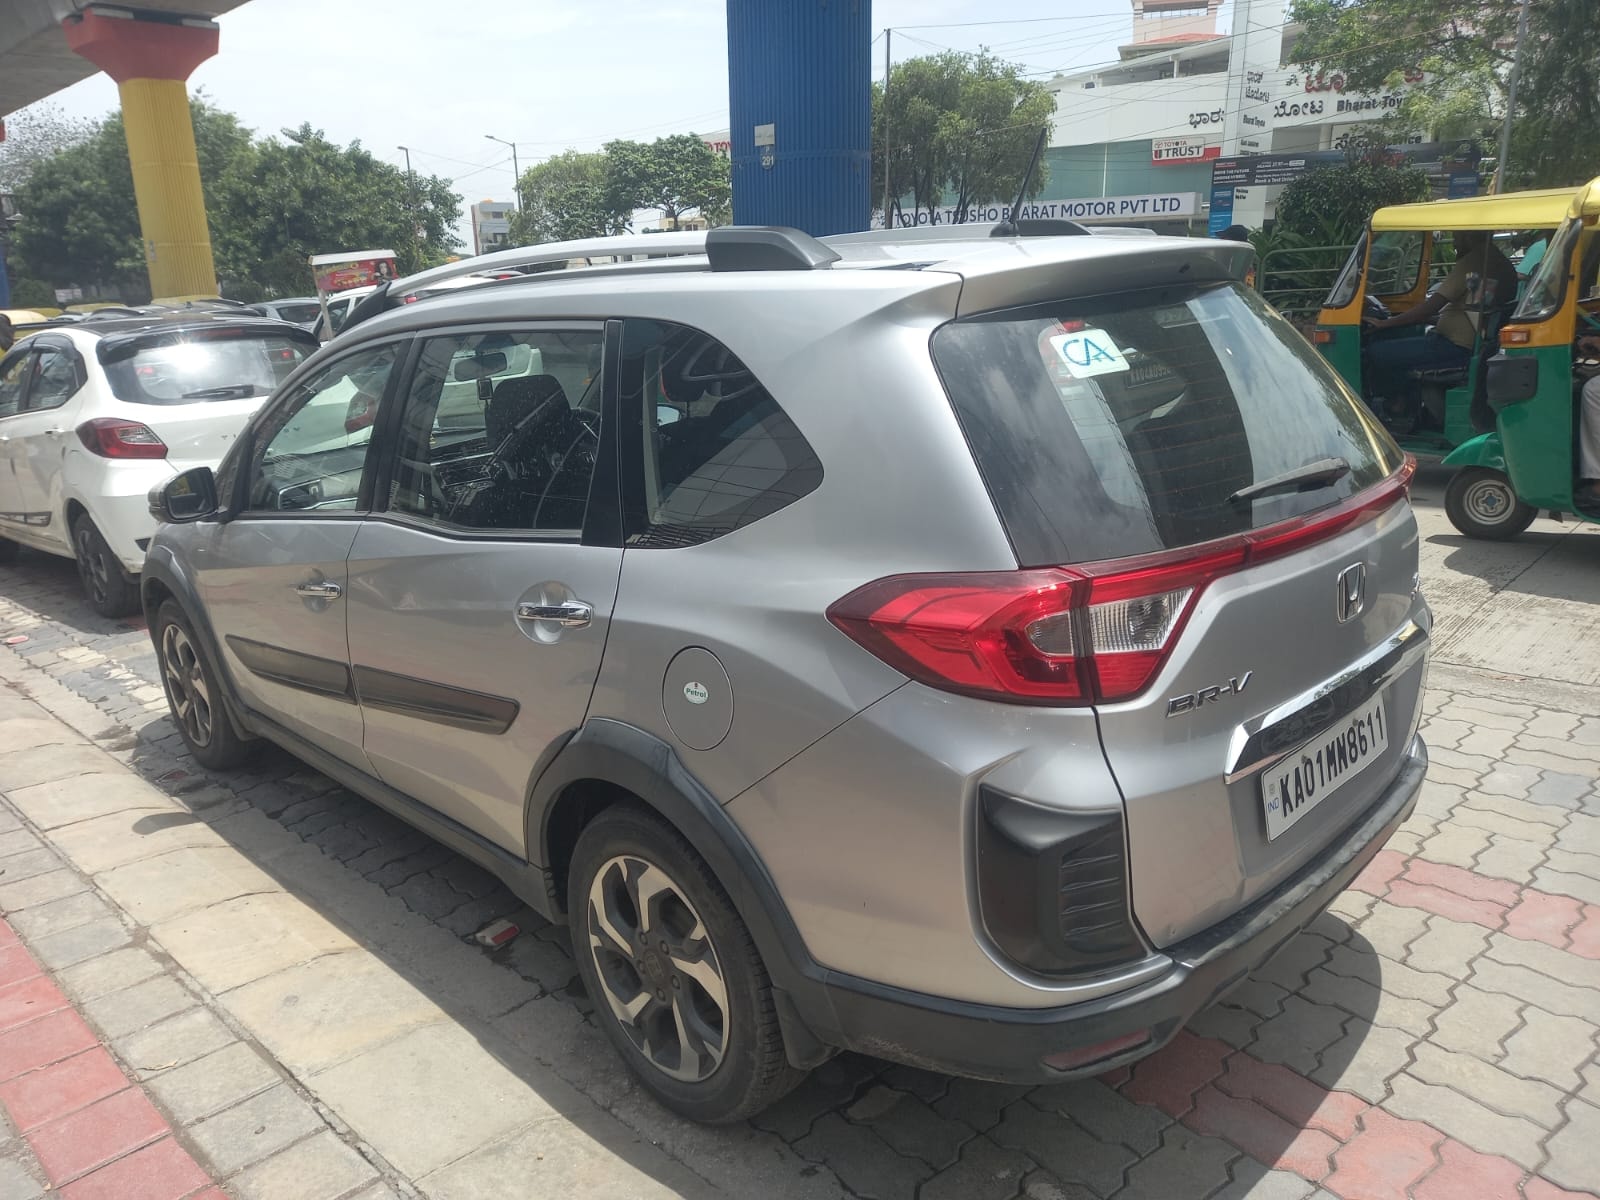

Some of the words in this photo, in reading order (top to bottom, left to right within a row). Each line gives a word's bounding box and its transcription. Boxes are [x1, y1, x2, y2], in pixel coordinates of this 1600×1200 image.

[1336, 98, 1378, 113] Bharat
[1382, 95, 1403, 110] Toy
[1165, 146, 1203, 158] TRUST
[1060, 201, 1115, 218] MOTOR
[1120, 199, 1149, 215] PVT
[1153, 197, 1181, 213] LTD
[686, 688, 707, 698] Petrol
[1166, 670, 1253, 718] BR-V
[1279, 705, 1384, 818] KA01MN8611
